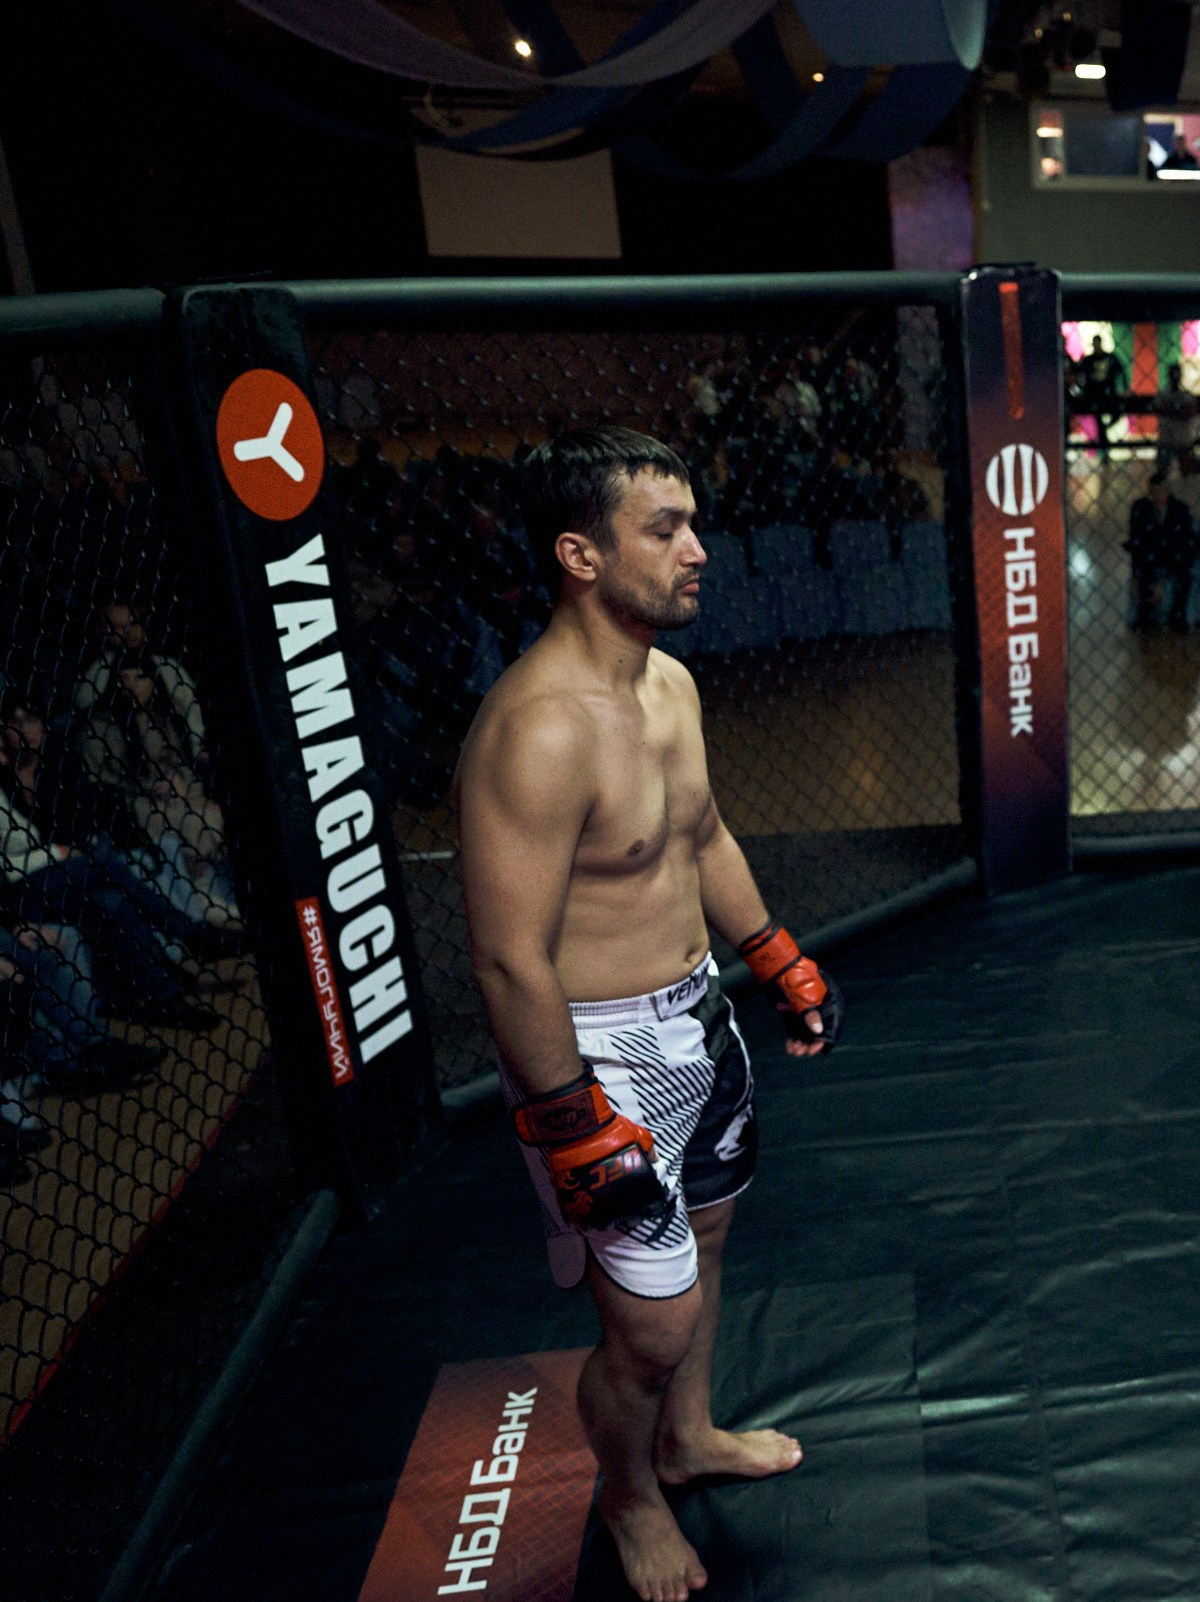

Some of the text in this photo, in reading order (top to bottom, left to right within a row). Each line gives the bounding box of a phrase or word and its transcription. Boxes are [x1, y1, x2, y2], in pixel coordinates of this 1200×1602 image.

[1002, 526, 1040, 739] НБД Банк
[264, 533, 413, 1063] YAMAGUCHI
[436, 1387, 538, 1596] НБД Банк
